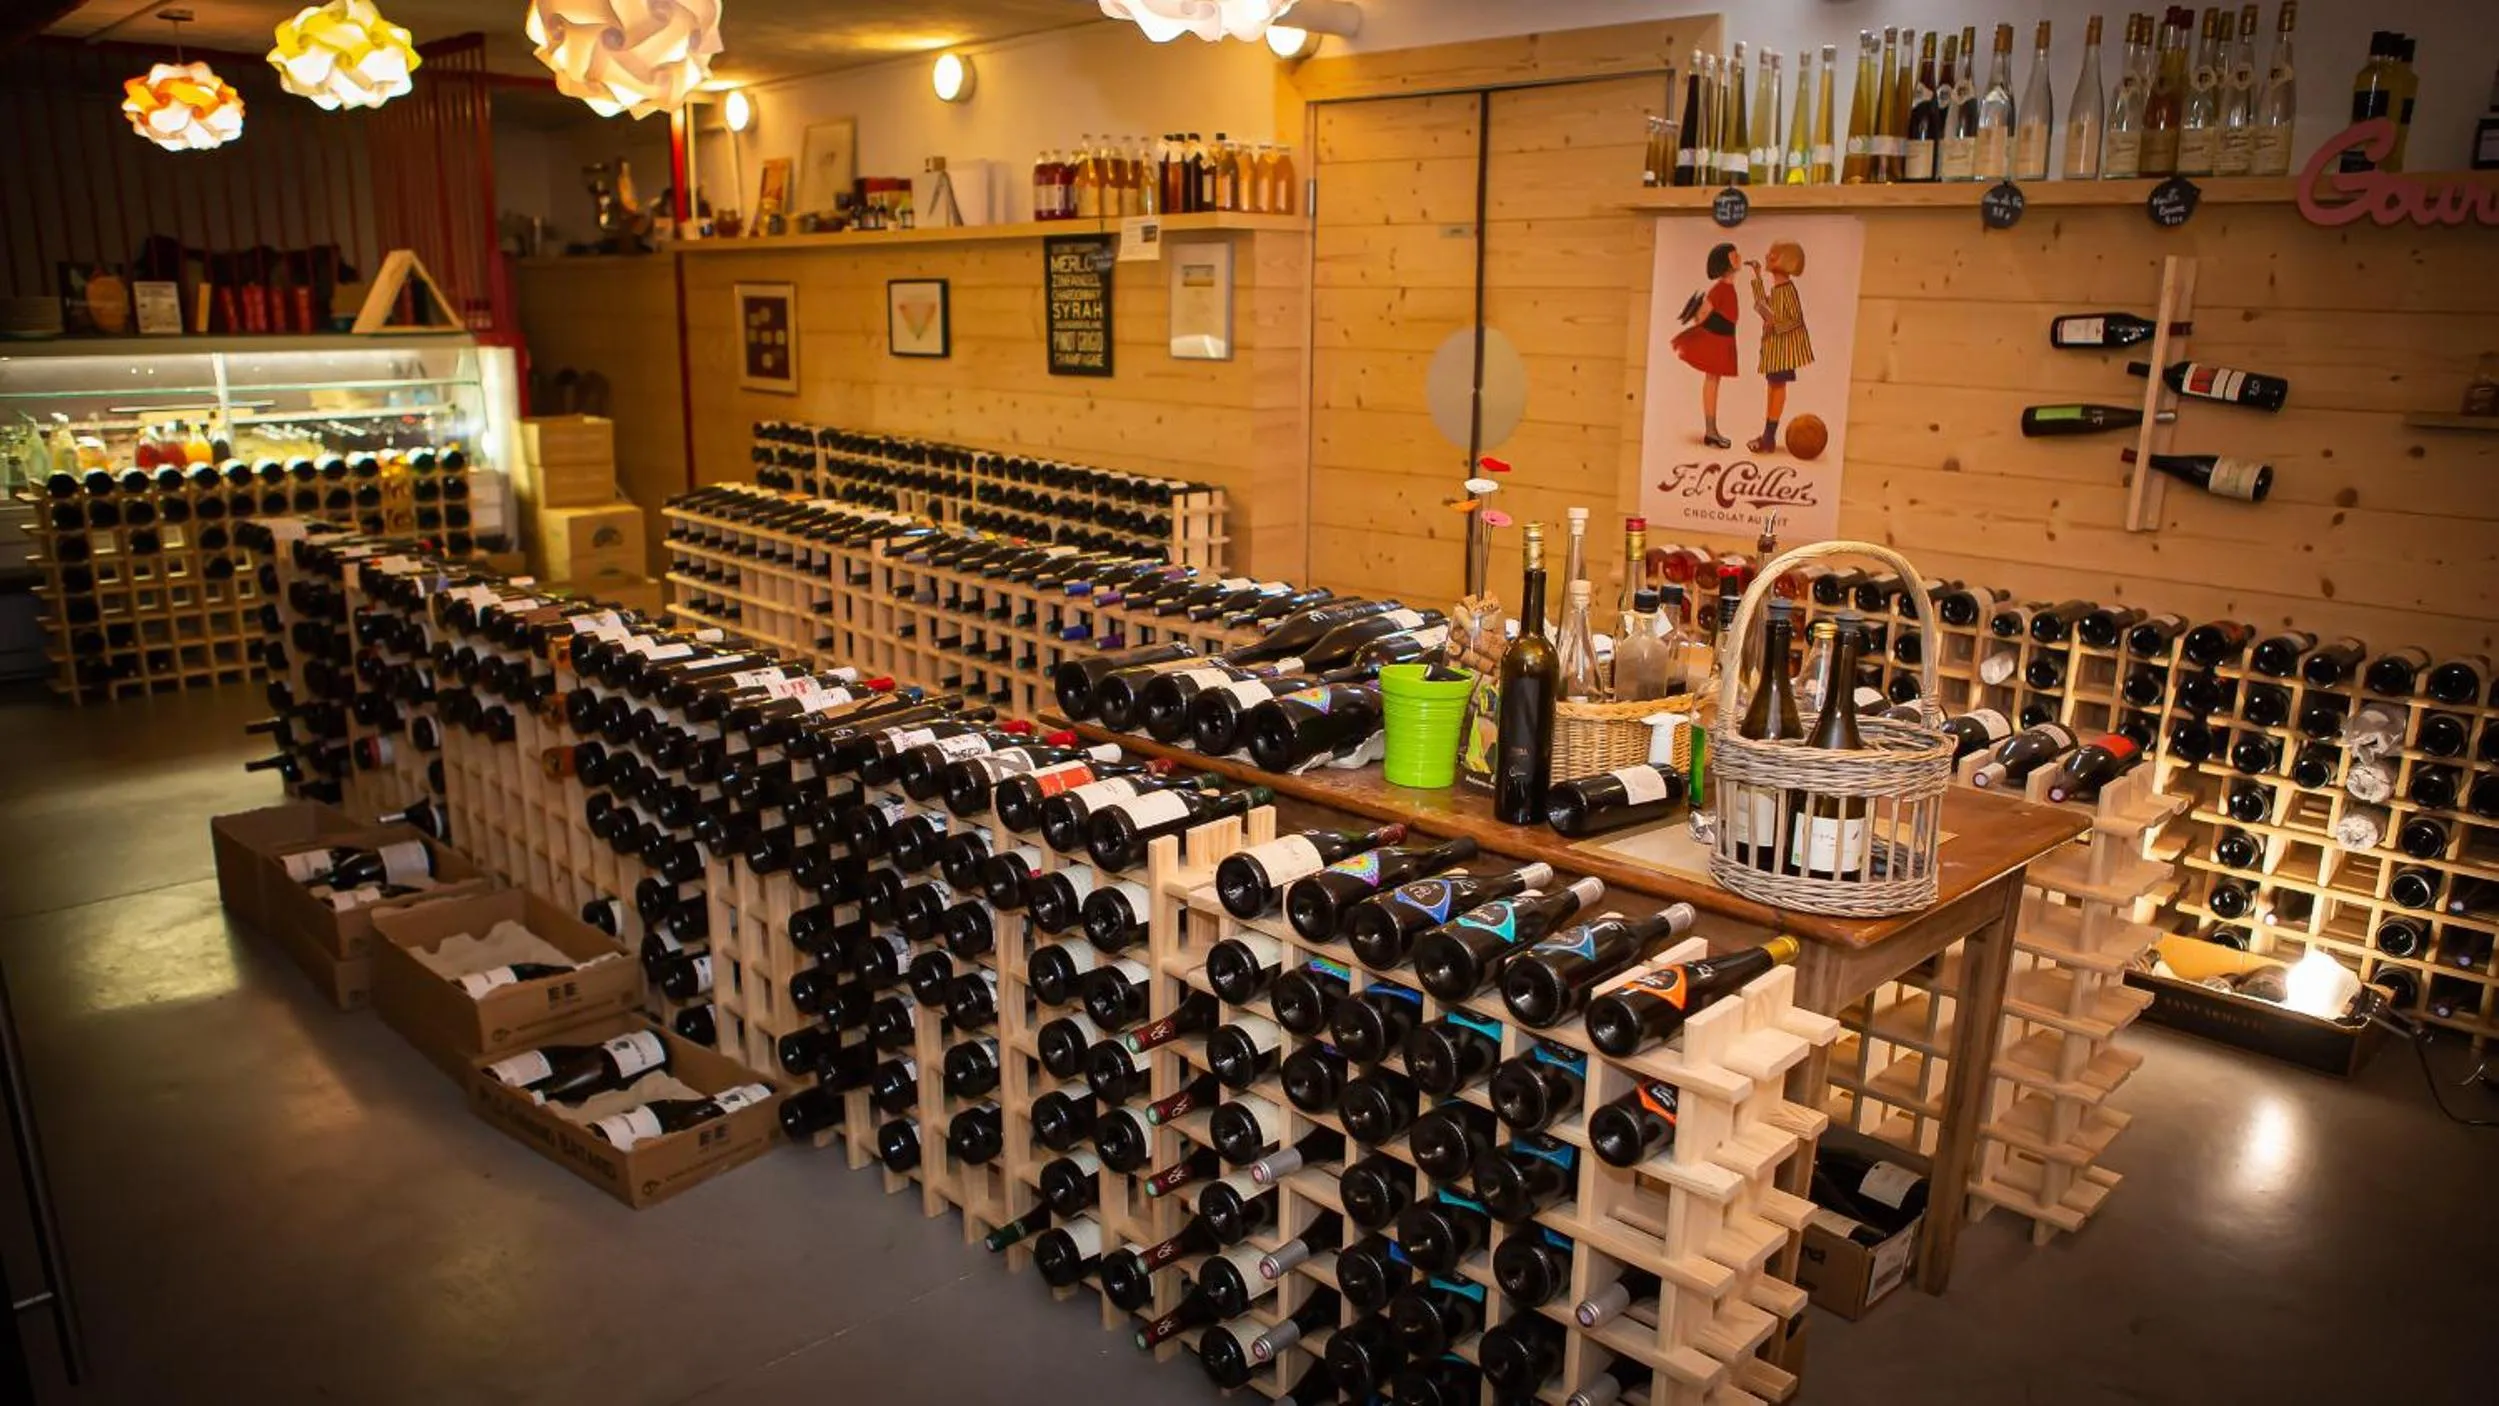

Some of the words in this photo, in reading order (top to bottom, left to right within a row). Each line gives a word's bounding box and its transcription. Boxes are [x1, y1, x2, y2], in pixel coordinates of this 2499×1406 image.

[1052, 302, 1104, 320] SYRAH
[1683, 506, 1745, 524] CHOCOLAT
[1747, 515, 1762, 525] AU
